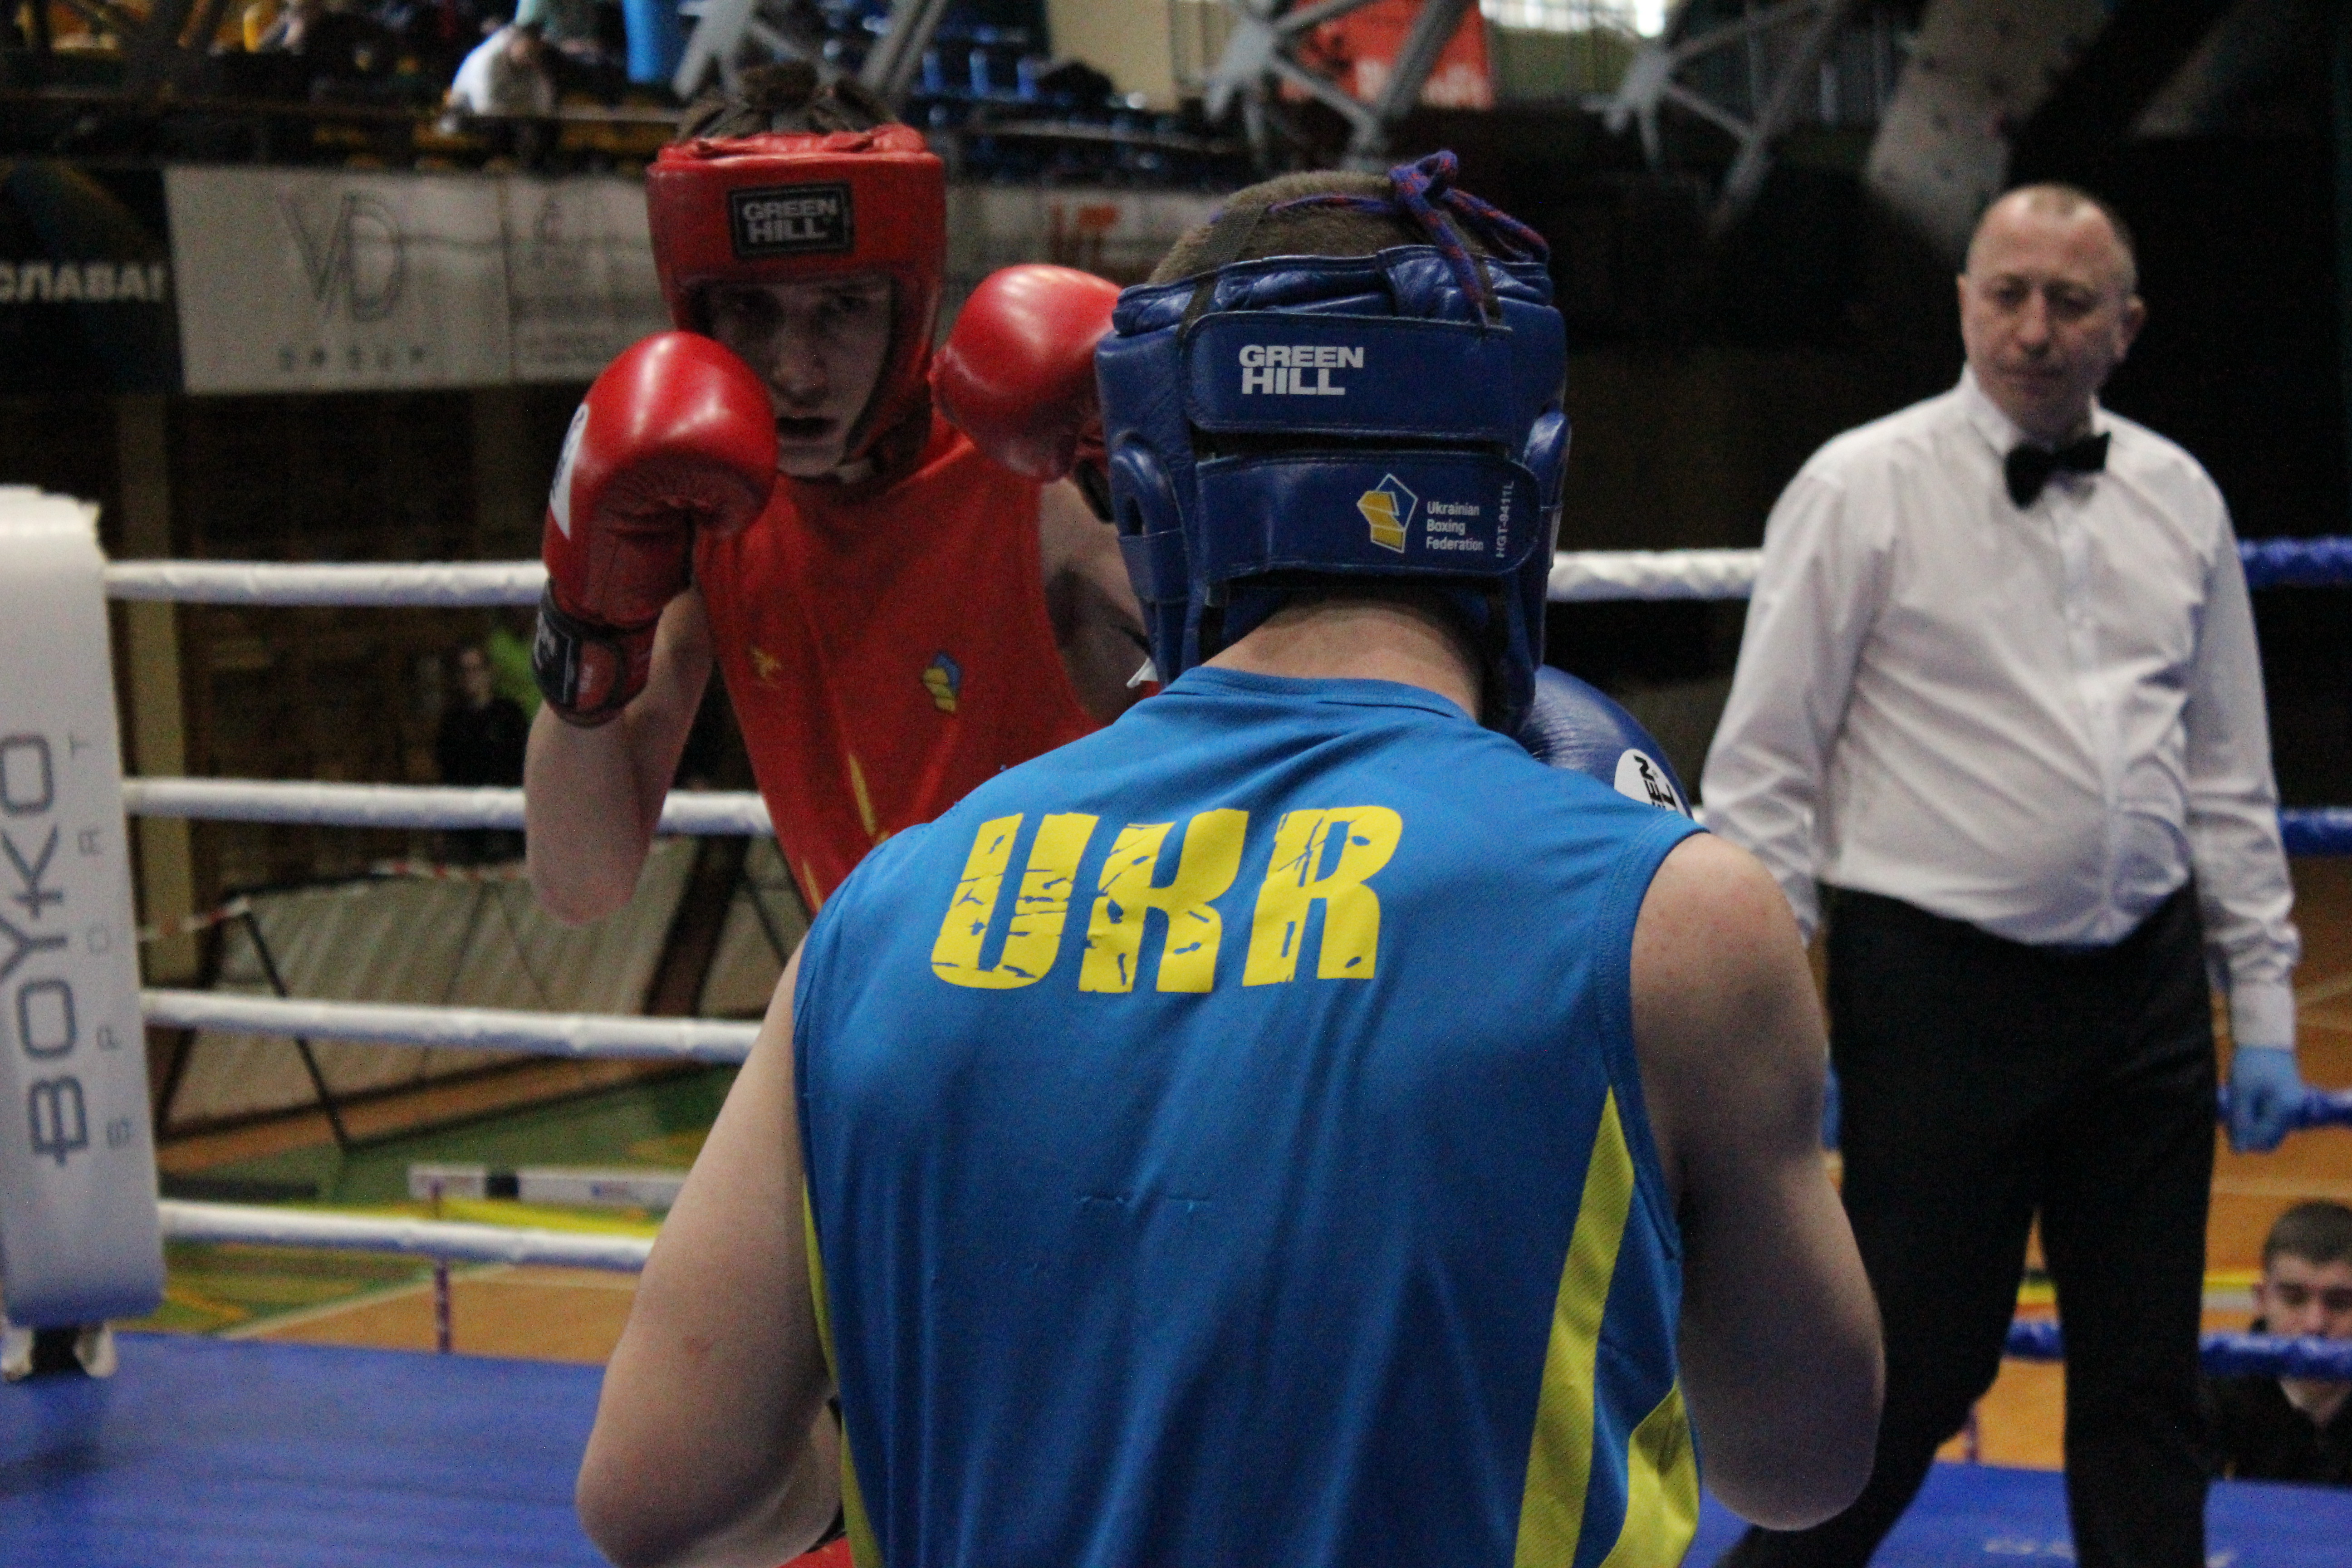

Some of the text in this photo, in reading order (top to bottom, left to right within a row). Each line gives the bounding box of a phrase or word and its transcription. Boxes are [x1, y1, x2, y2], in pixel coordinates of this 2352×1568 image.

[743, 199, 837, 220] GREEN
[748, 218, 827, 243] HILL
[1239, 345, 1364, 368] GREEN
[1242, 367, 1346, 395] HILL
[1427, 501, 1480, 516] Ukrainian
[1495, 481, 1514, 558] HGT-9411L
[1426, 519, 1466, 536] Boxing
[1426, 536, 1484, 551] Federation
[931, 805, 1403, 994] UKR
[0, 734, 88, 1166] BOYKO
[68, 731, 132, 1151] SPORT
